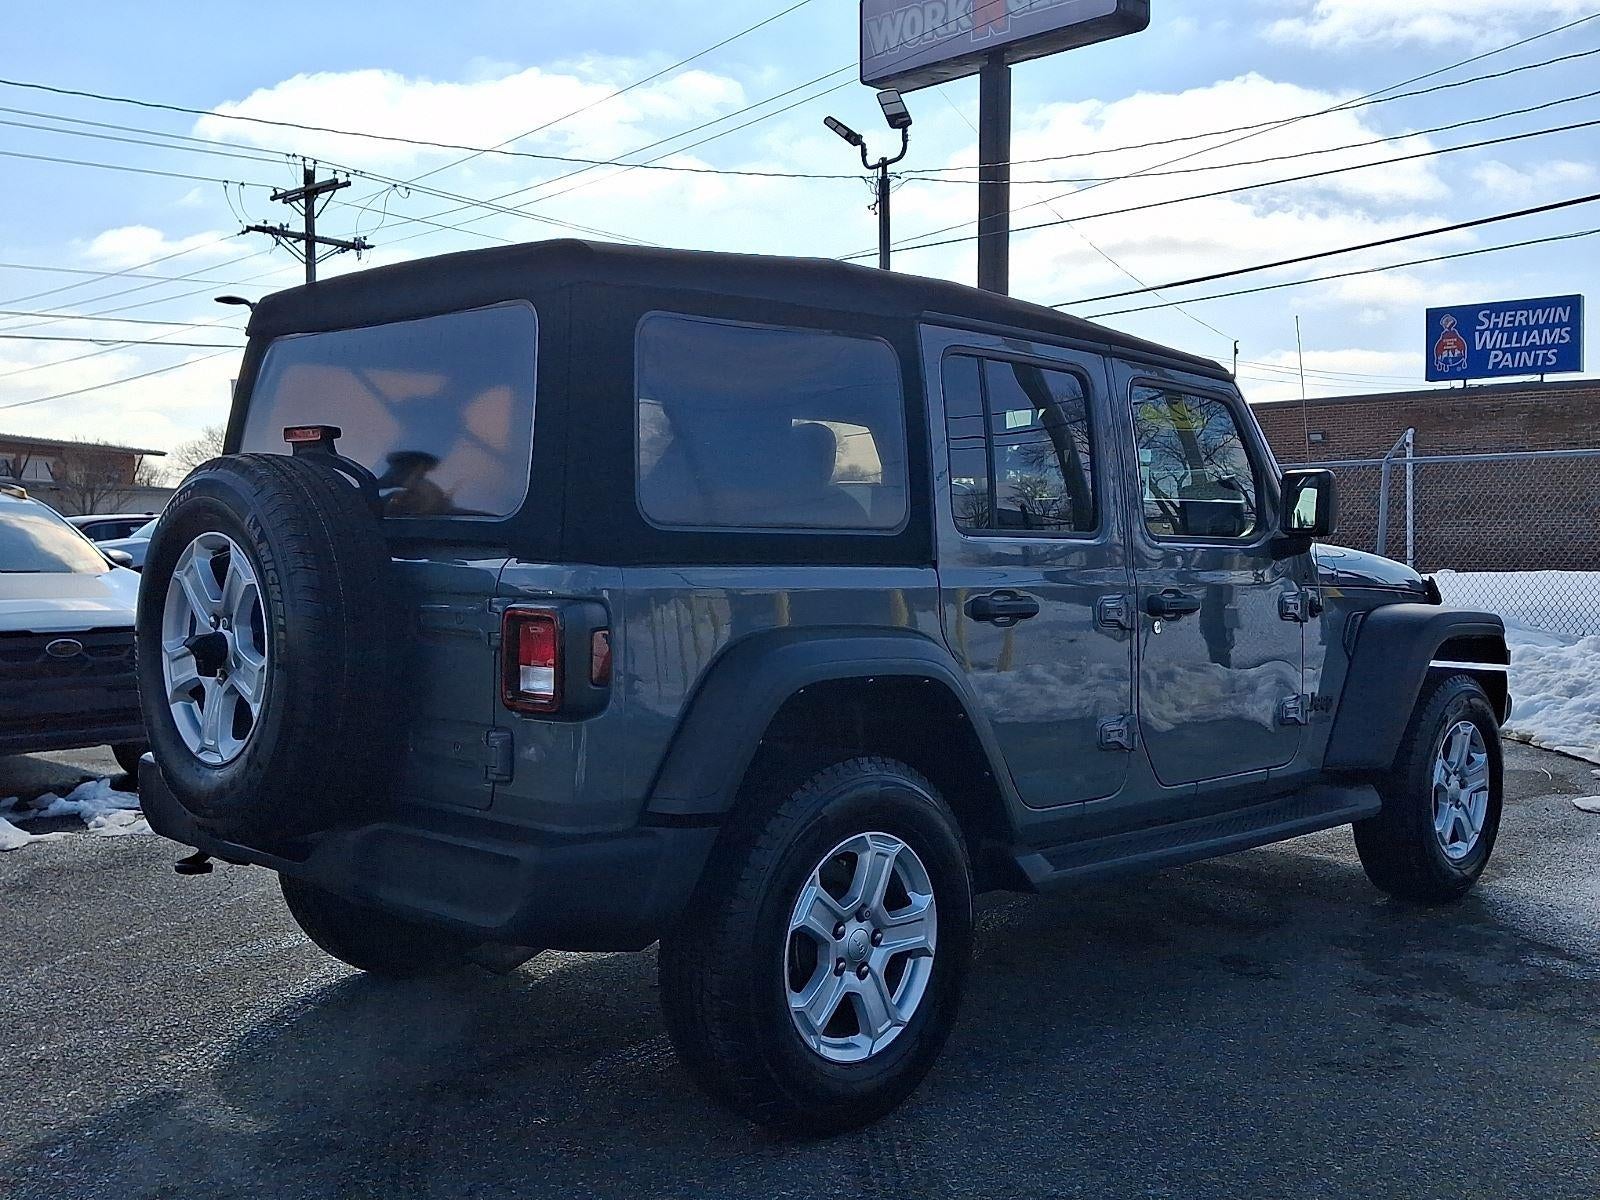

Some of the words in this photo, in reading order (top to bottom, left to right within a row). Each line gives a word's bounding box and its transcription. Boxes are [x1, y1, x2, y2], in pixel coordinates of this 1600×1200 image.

[865, 0, 972, 57] WORK
[1476, 306, 1571, 330] SHERWIN
[1475, 327, 1571, 350] WILLIAMS
[1487, 349, 1558, 369] PAINTS
